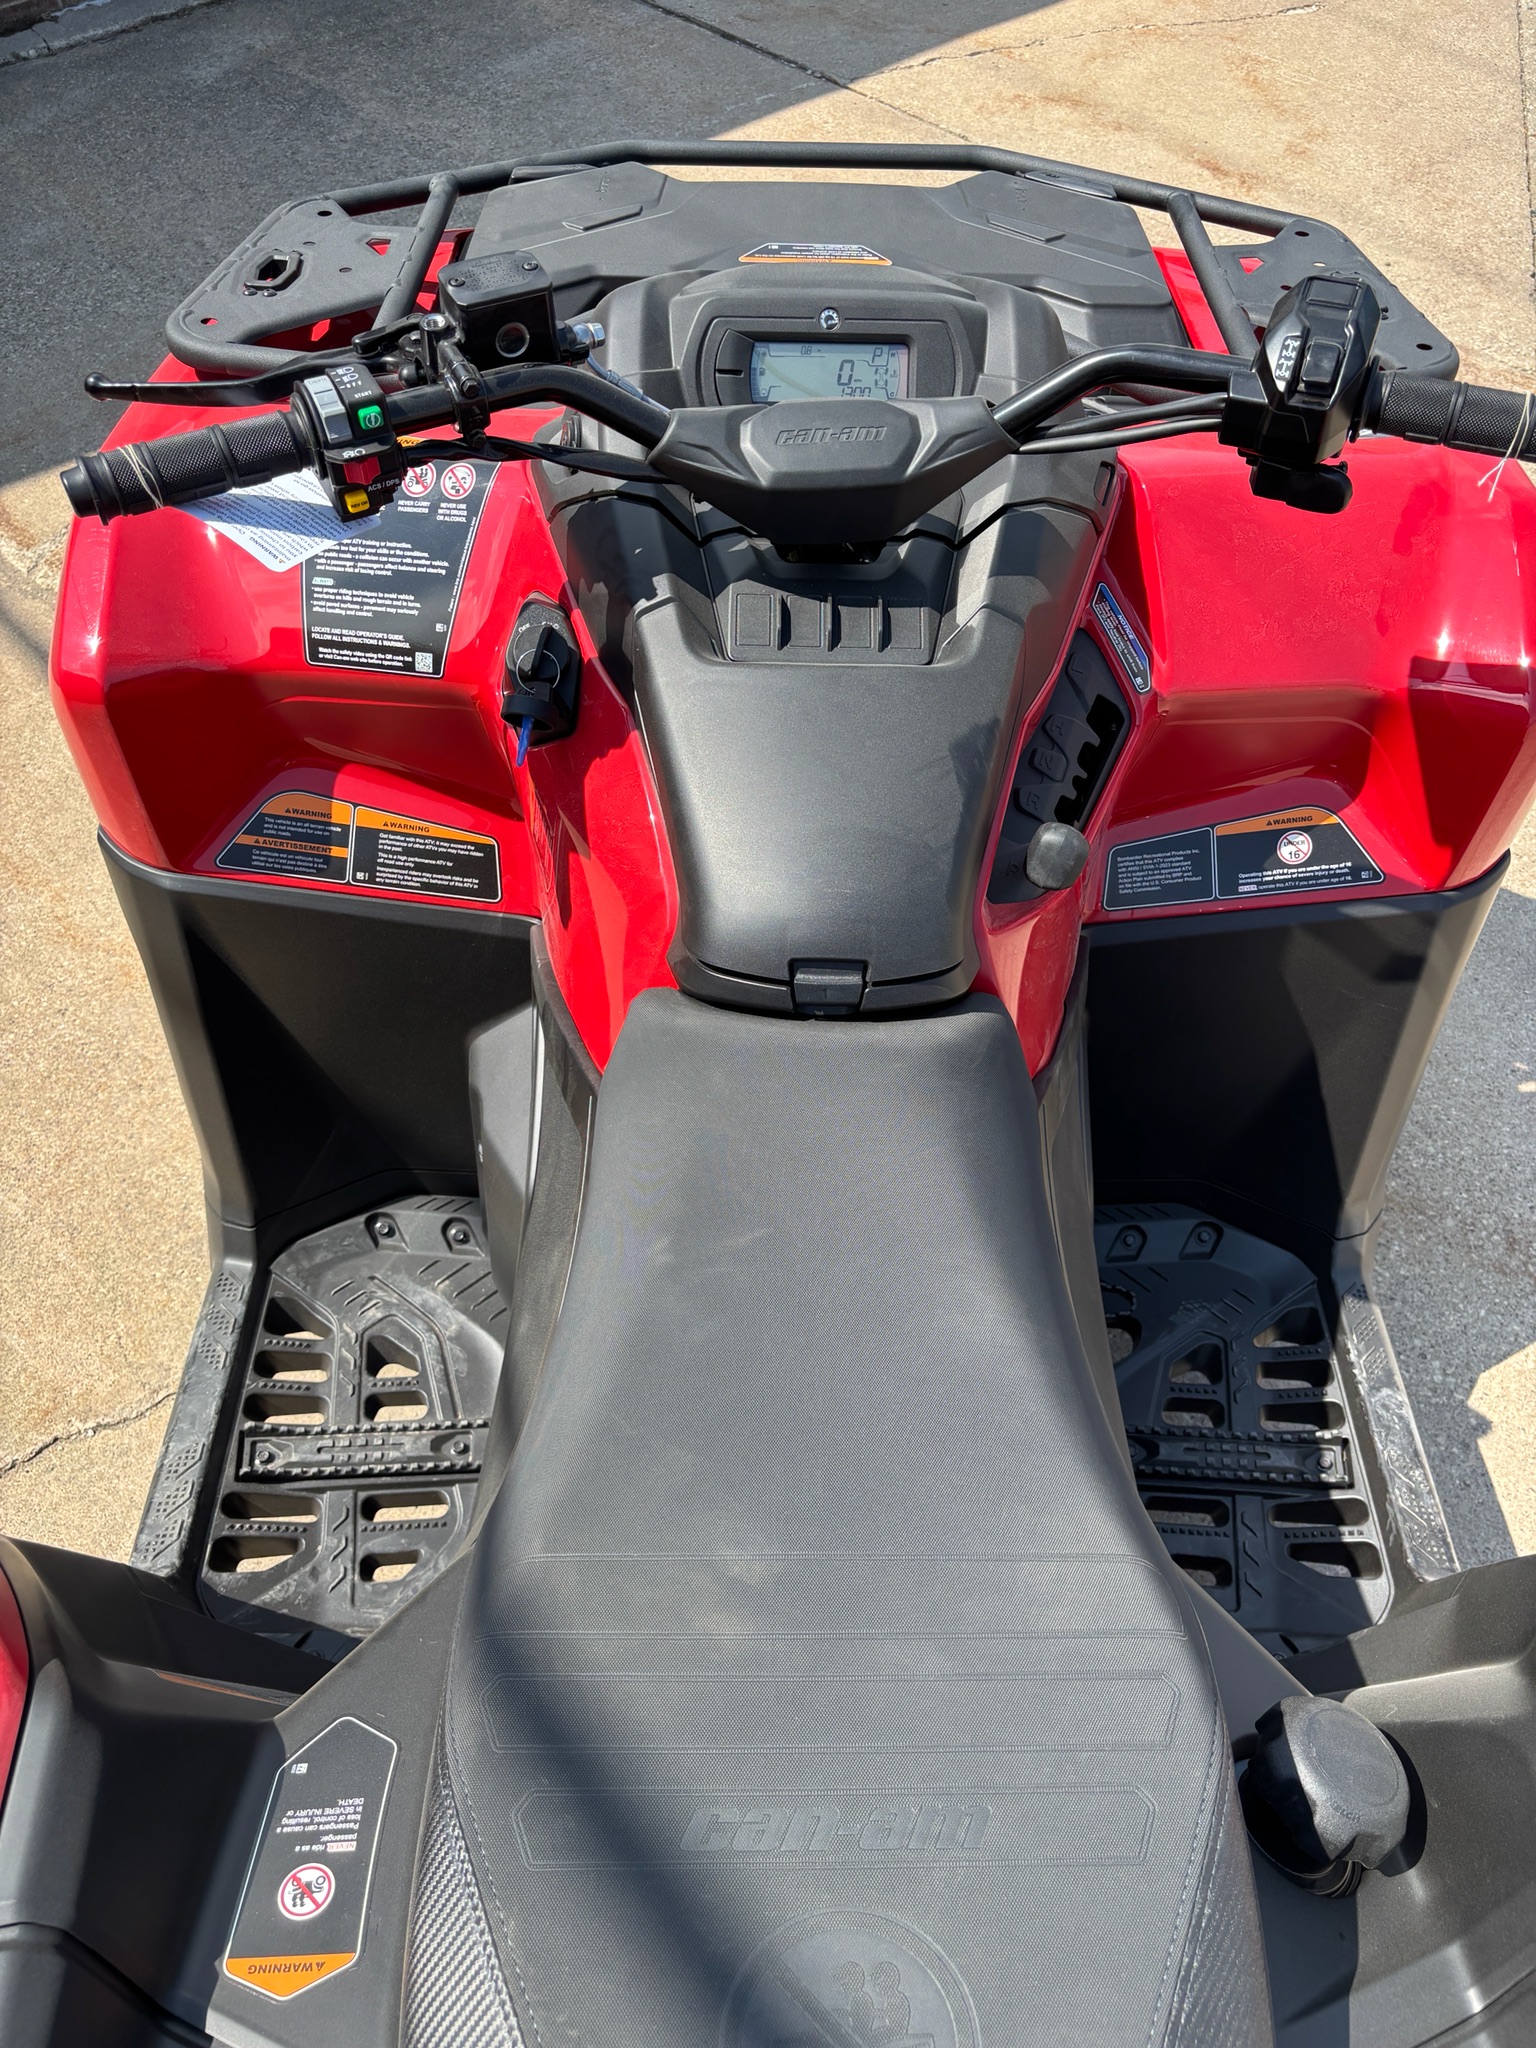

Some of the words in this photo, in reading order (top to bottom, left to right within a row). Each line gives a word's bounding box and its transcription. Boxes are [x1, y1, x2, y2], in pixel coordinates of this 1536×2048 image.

[871, 347, 883, 364] P
[837, 359, 855, 386] 0
[346, 380, 362, 389] OFF
[354, 390, 372, 398] START
[776, 426, 887, 445] can-am
[368, 482, 382, 492] ACS
[386, 478, 400, 487] DPS
[362, 540, 379, 548] training
[338, 589, 351, 597] riding
[353, 591, 377, 599] techniques
[326, 608, 345, 616] handling
[363, 605, 385, 613] pavement
[397, 608, 420, 616] seriously
[1117, 614, 1134, 640] NOTICE
[356, 631, 387, 639] OPERATOR'S
[312, 633, 331, 641] FOLLOW
[342, 636, 377, 645] INSTRUCTIONS
[383, 640, 411, 648] WARNINGS.
[292, 808, 332, 819] WARNING
[1273, 816, 1313, 825] WARNING
[390, 822, 430, 833] WARNING
[262, 839, 332, 854] AVERTISSEMENT
[379, 839, 407, 849] performance
[1284, 839, 1306, 847] UNDER
[1164, 856, 1184, 864] complies
[1288, 850, 1301, 860] 16
[408, 856, 435, 865] performance
[1160, 867, 1181, 875] approved
[1239, 871, 1261, 880] Operating
[1314, 870, 1328, 878] injury
[337, 1797, 364, 1805] DEATH.
[295, 1808, 323, 1816] INJURY
[323, 1806, 355, 1814] SEVERE
[281, 1815, 311, 1825] resulting
[312, 1813, 337, 1823] control,
[346, 1813, 361, 1821] loss
[318, 1820, 359, 1831] Passengers
[680, 1804, 993, 1851] can-am
[328, 1842, 354, 1850] NEVER
[248, 1960, 313, 1974] WARNING
